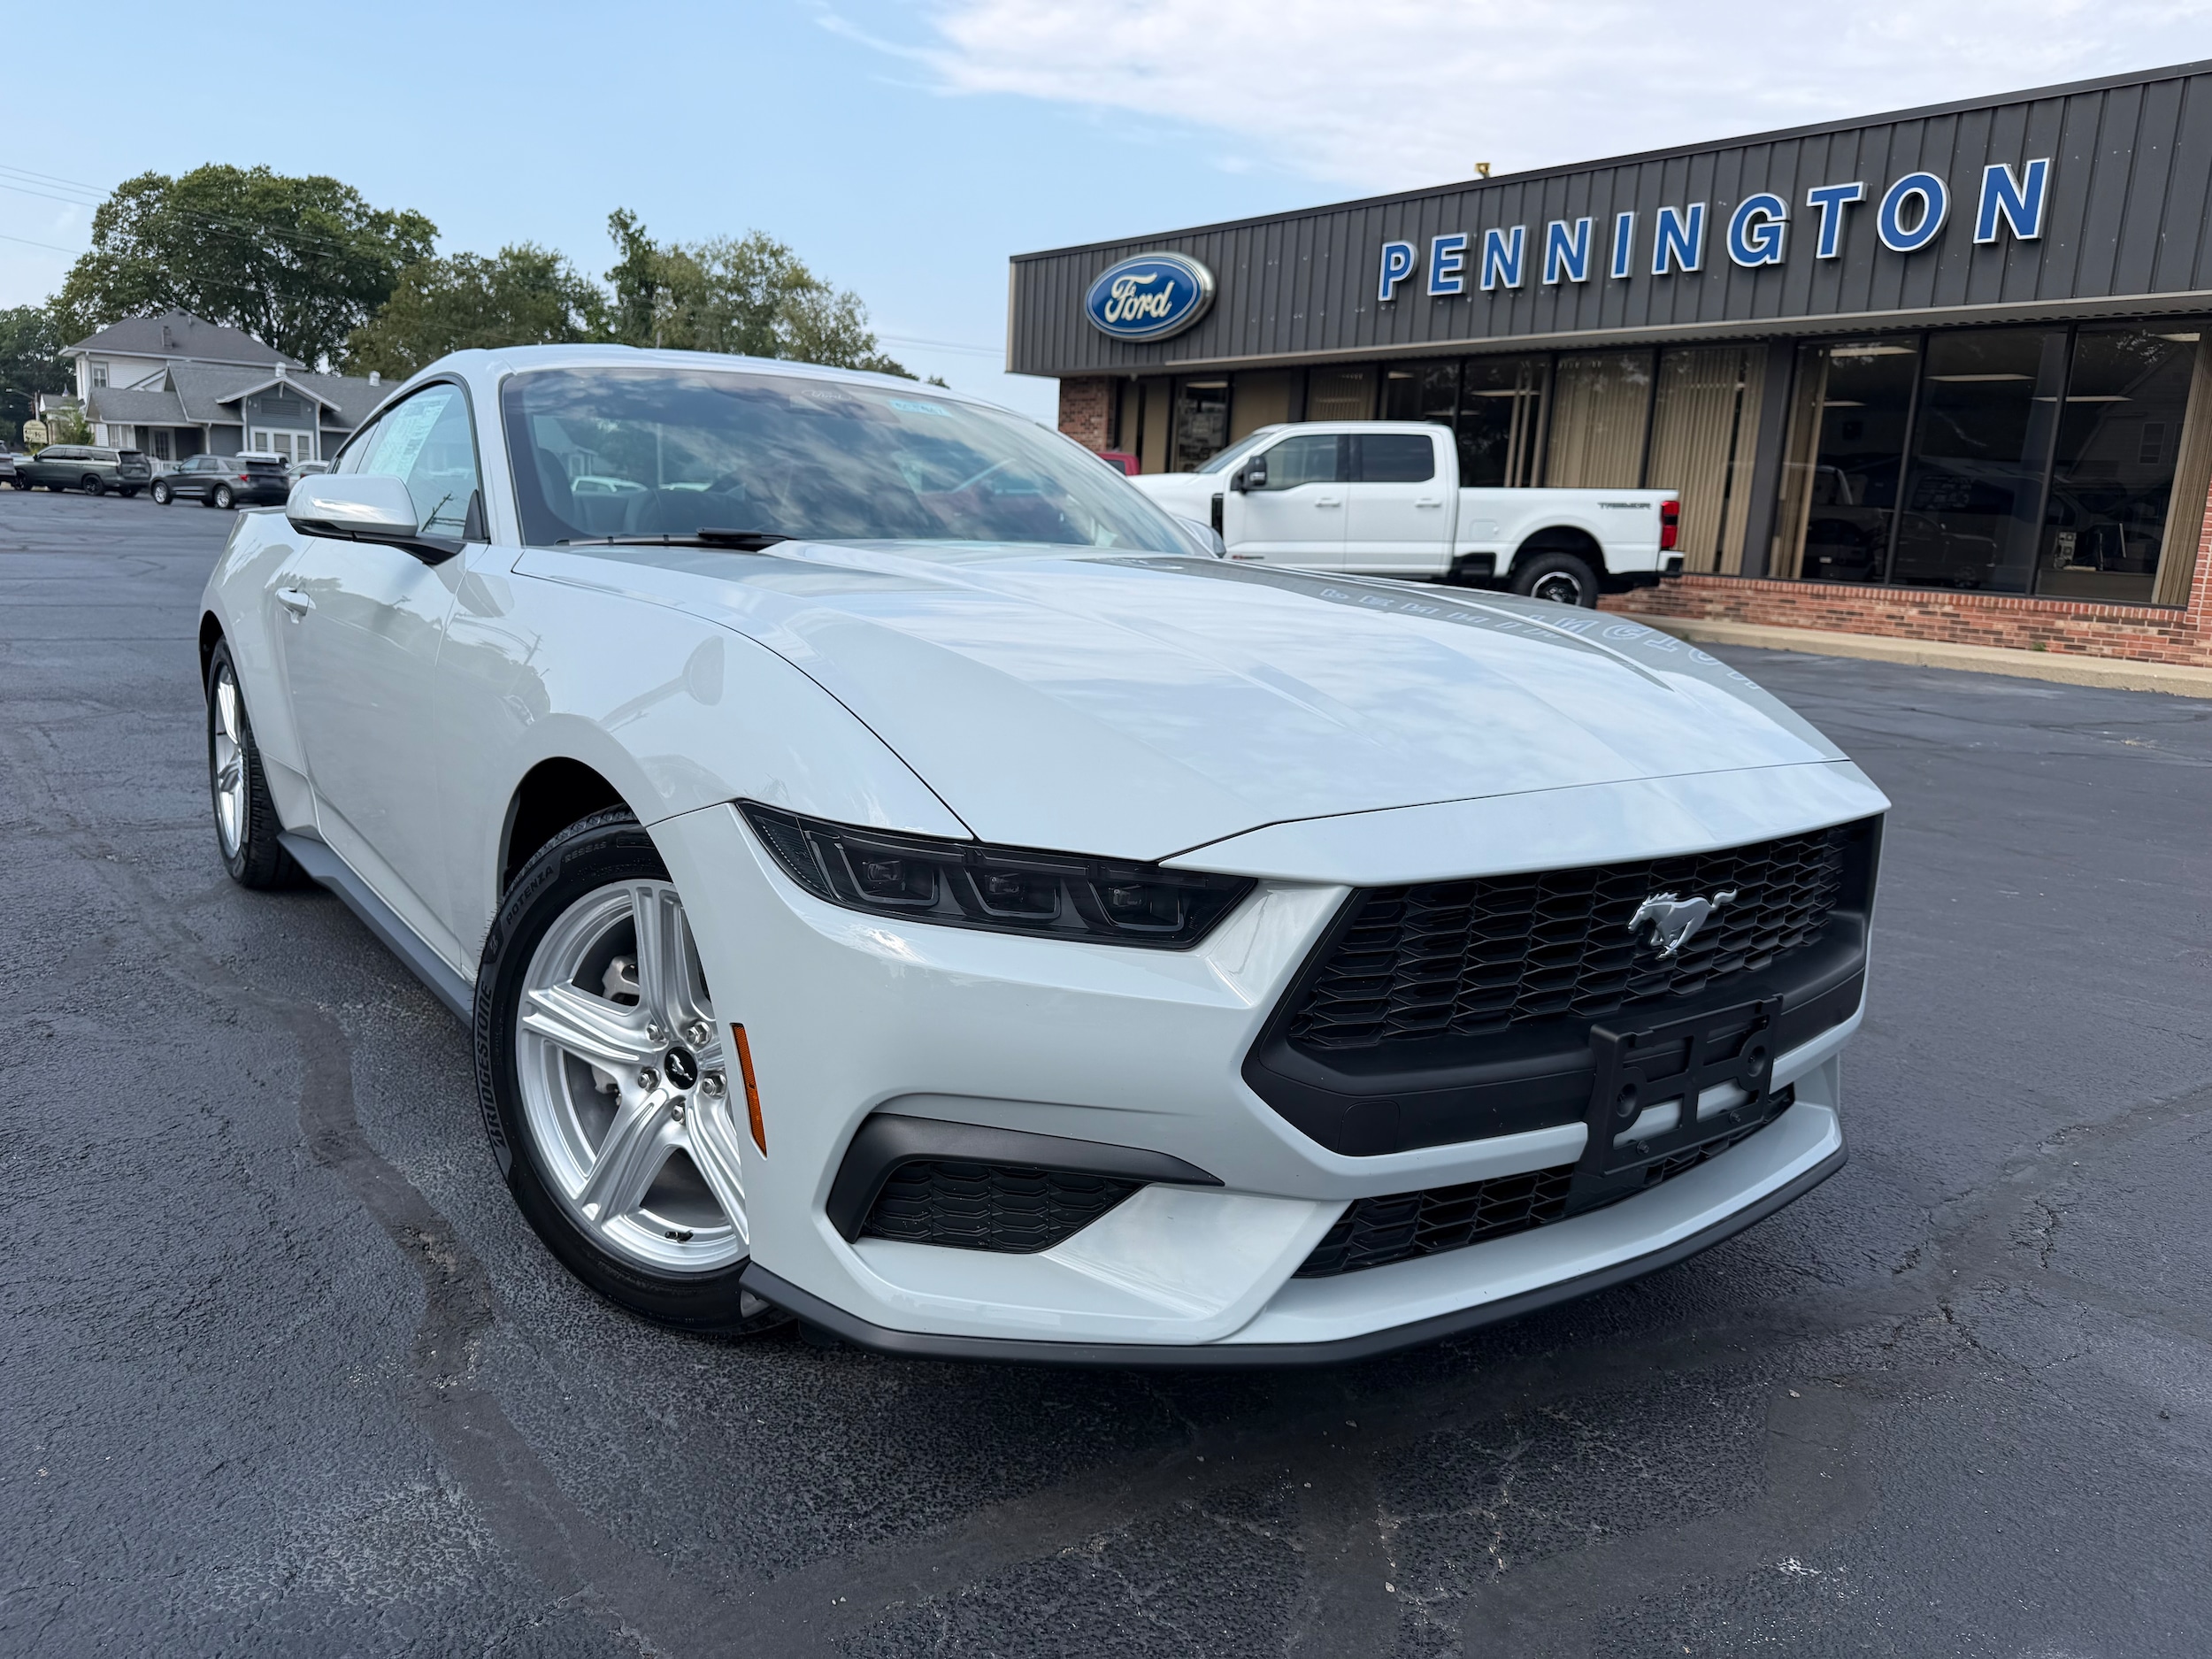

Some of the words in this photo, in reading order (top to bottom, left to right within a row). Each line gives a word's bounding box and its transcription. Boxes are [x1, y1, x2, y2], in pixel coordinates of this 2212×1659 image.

[1377, 157, 2052, 303] PENNINGTON
[1104, 272, 1175, 325] Ford
[506, 864, 555, 926] POTENZA
[475, 980, 507, 1149] BRIDGESTONE
